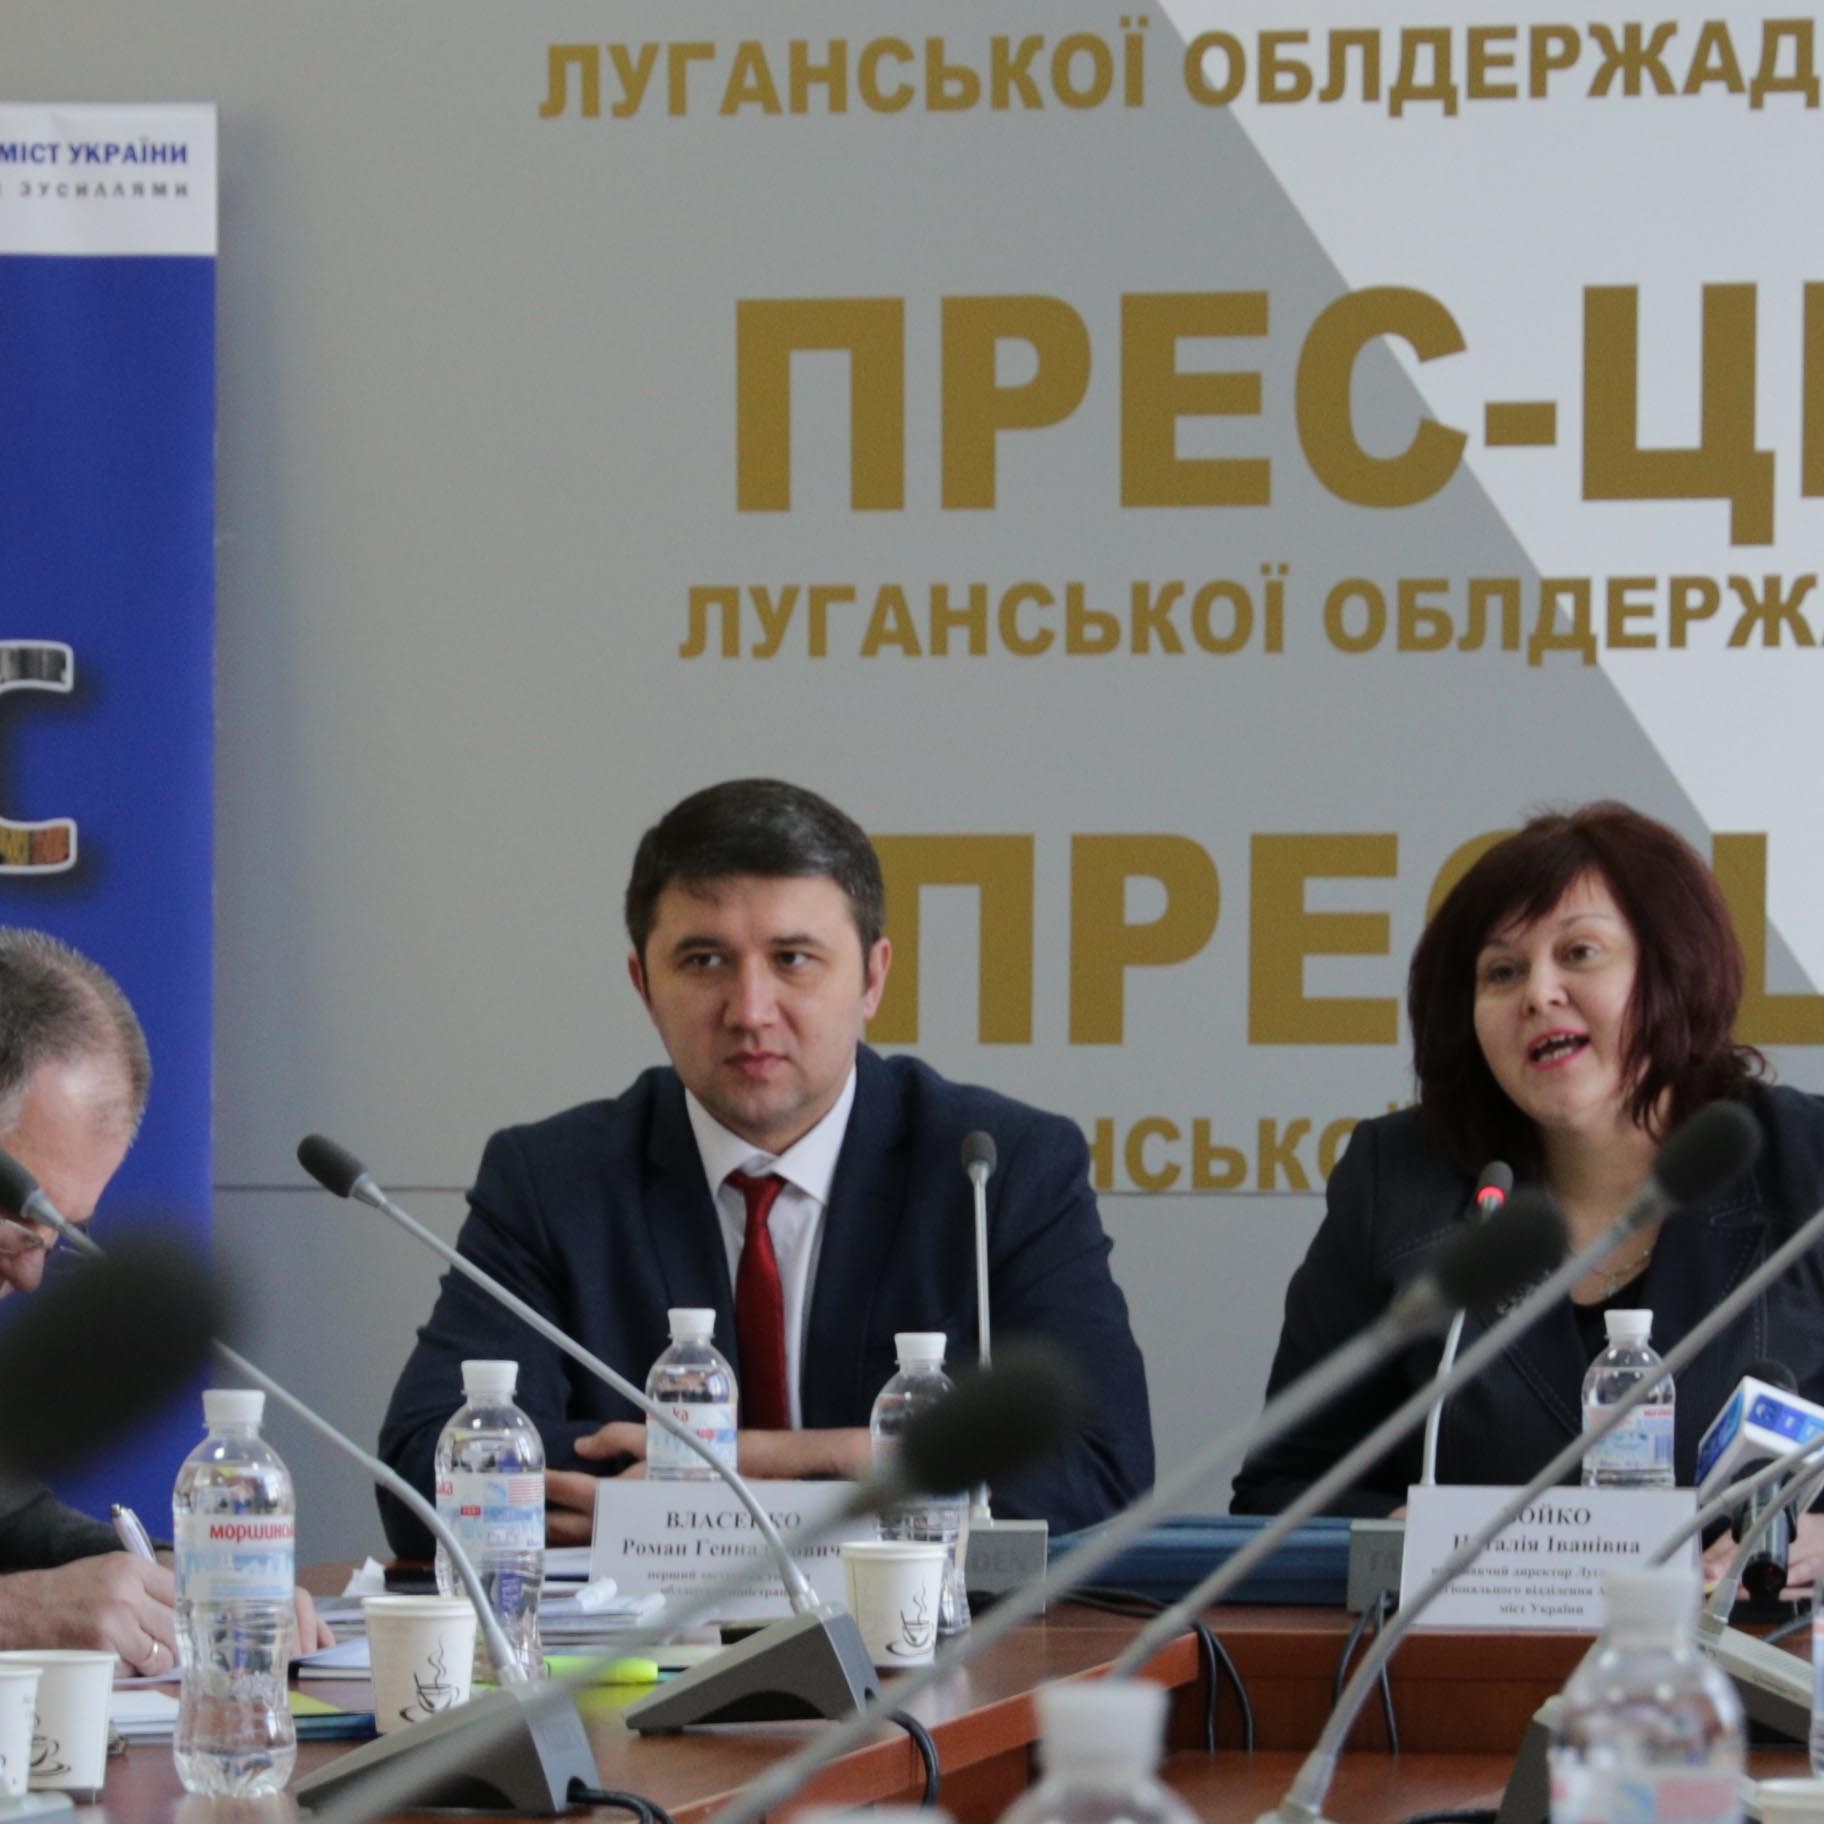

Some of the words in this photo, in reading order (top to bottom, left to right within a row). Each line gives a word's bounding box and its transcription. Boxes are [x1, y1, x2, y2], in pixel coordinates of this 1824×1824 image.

[538, 15, 1149, 118] ЛУГАНСЬКОЇ
[68, 137, 189, 165] УКРАЇНИ
[678, 563, 1290, 660] ЛУГАНСЬКОЇ
[1513, 1505, 1592, 1526] ОЙКО
[622, 1538, 687, 1557] Роман
[1452, 1533, 1540, 1553] Нталія
[1546, 1535, 1641, 1555] Іванівна
